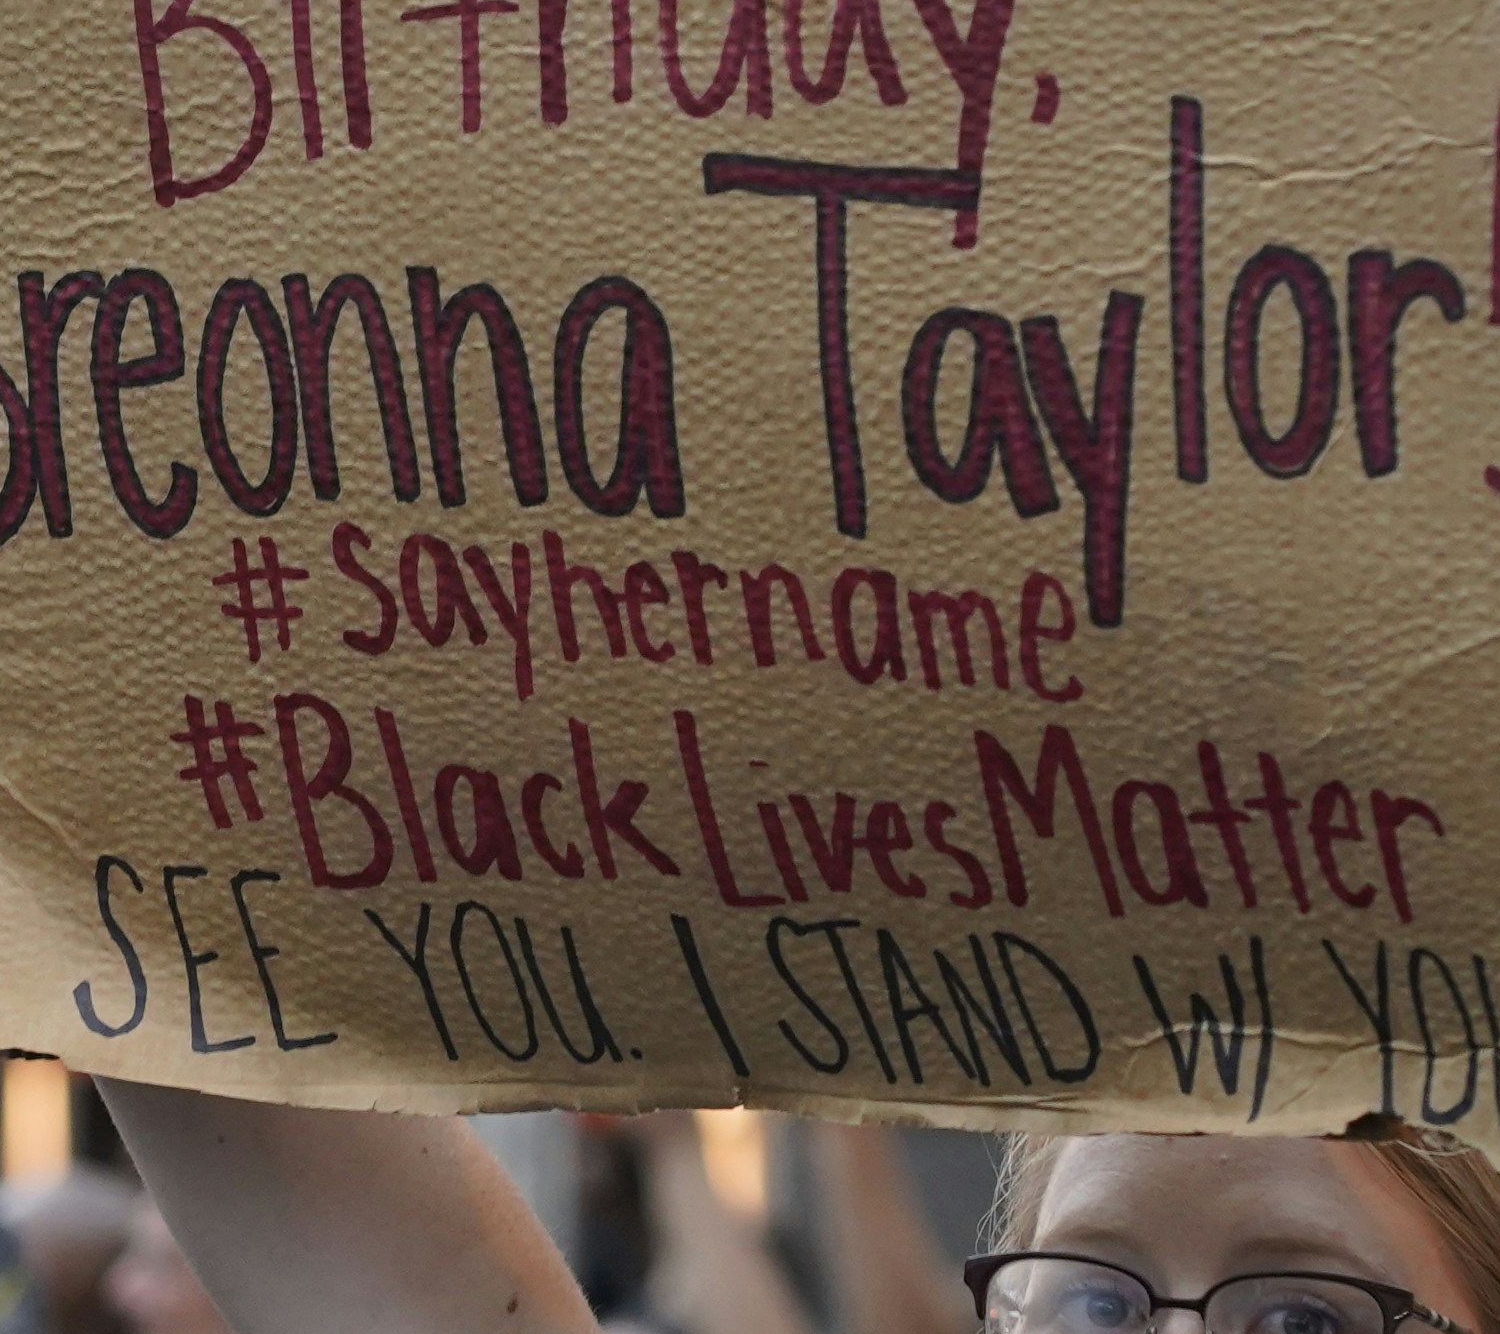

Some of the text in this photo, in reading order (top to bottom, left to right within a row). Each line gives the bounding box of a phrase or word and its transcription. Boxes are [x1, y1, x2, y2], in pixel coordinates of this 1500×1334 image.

[73, 855, 339, 1053] SEE
[363, 900, 645, 1064] YOU.
[669, 914, 750, 1079] I
[764, 917, 1103, 1087] STAND
